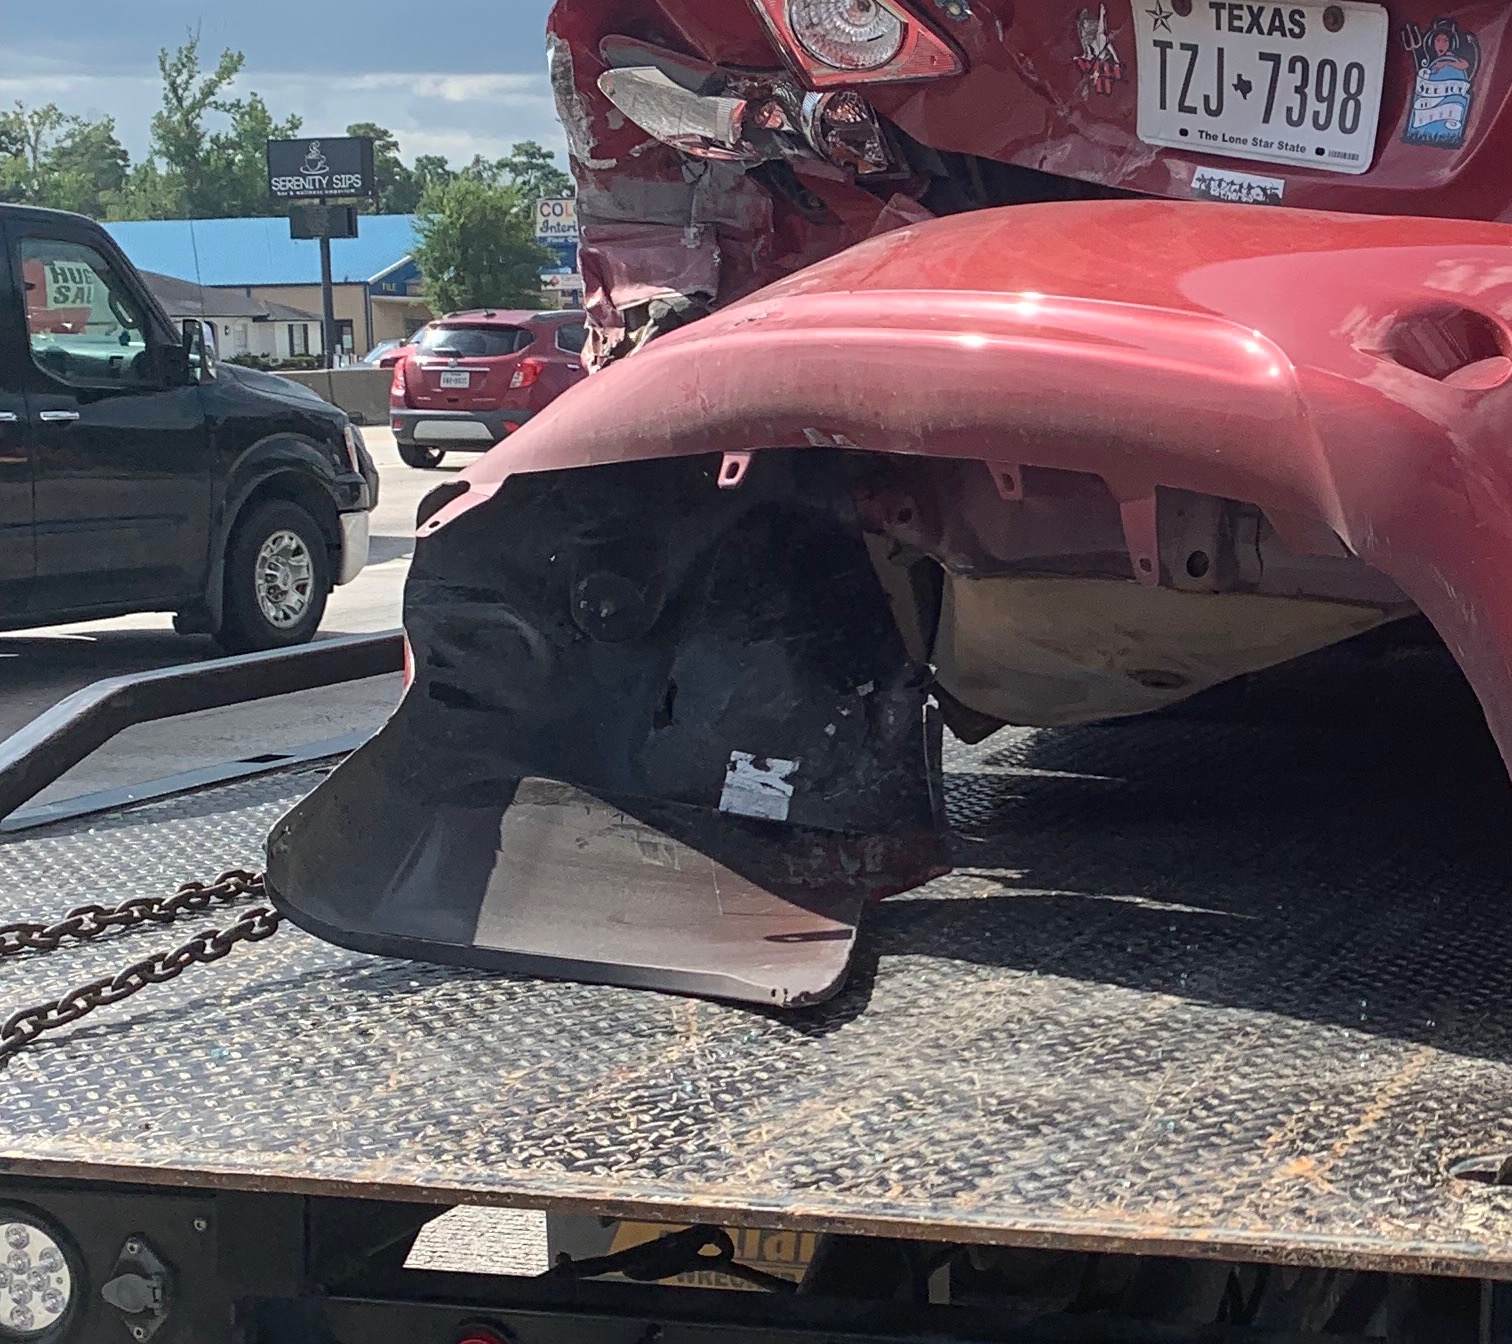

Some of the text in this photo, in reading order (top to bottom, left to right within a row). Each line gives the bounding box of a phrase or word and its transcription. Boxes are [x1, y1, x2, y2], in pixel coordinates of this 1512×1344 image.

[1209, 2, 1306, 39] TEXAS
[1198, 130, 1307, 154] The Lone Star State
[271, 174, 362, 191] SERENITY SIPS
